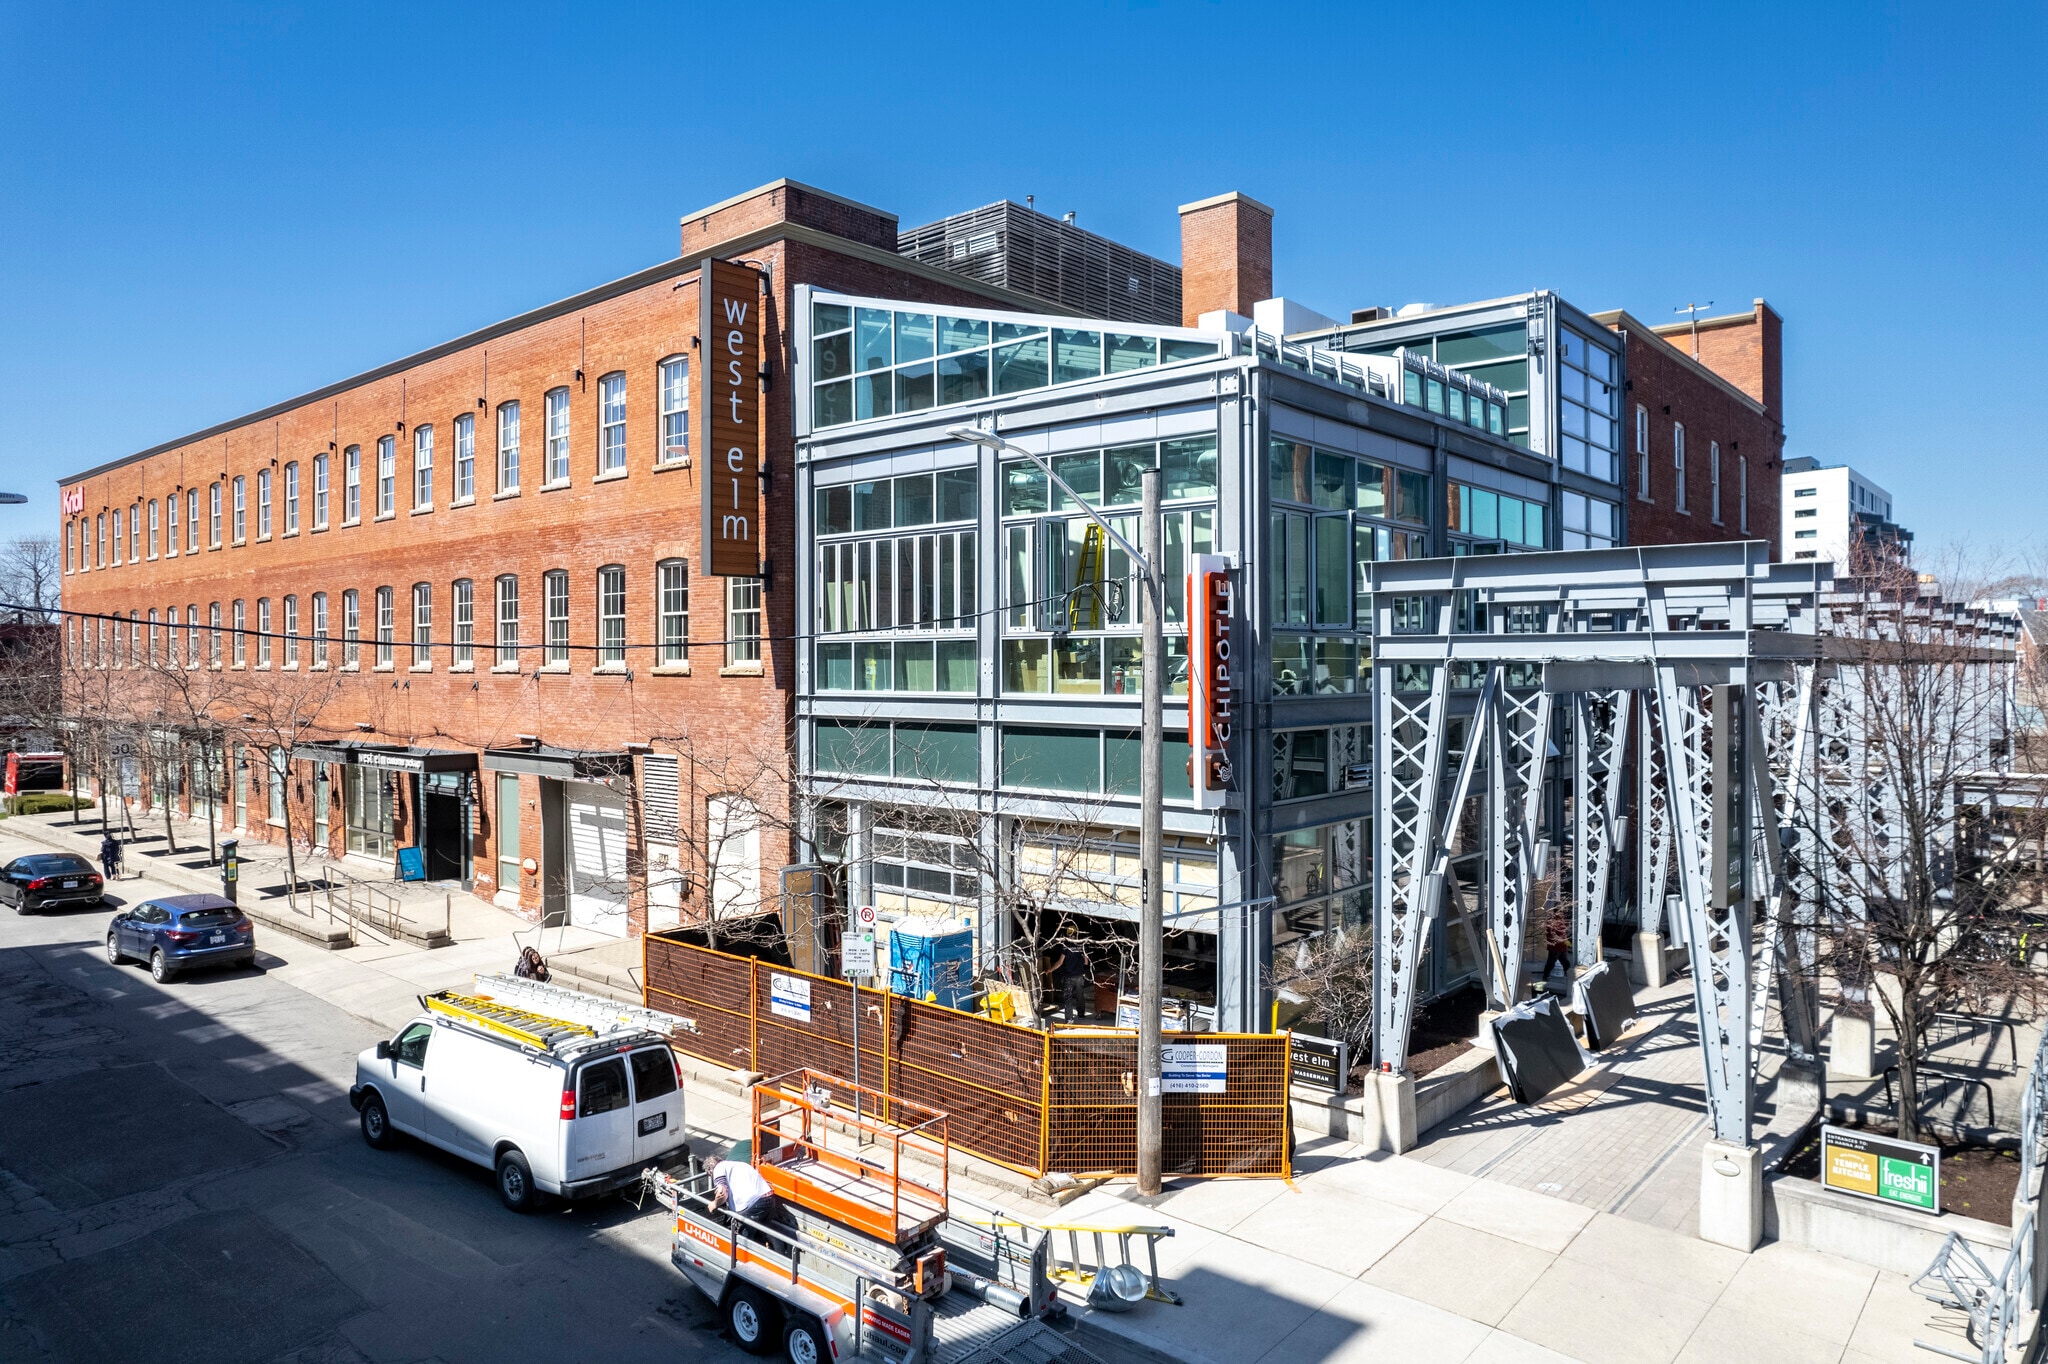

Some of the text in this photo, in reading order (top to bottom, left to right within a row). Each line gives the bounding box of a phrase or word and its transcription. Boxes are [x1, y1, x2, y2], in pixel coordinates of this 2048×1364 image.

[722, 297, 748, 541] west elm
[1216, 579, 1231, 742] CHIPOTLE
[111, 743, 130, 755] 30
[1732, 701, 1740, 842] west elm
[1729, 858, 1742, 874] entry
[1175, 1050, 1223, 1061] COOPER-GORDON
[1311, 1056, 1329, 1067] elm
[1294, 1070, 1329, 1081] WASSERMAN
[1827, 1134, 1858, 1144] ENTRANCES
[1834, 1140, 1853, 1148] HANNA
[1834, 1157, 1869, 1172] TEMPLE
[1832, 1165, 1872, 1181] KITCHEN
[1883, 1159, 1927, 1193] freshii
[684, 1222, 720, 1249] U-HAUL
[812, 1229, 845, 1247] KEEP CLEAR
[863, 1313, 911, 1339] MOVING MADE EASIER
